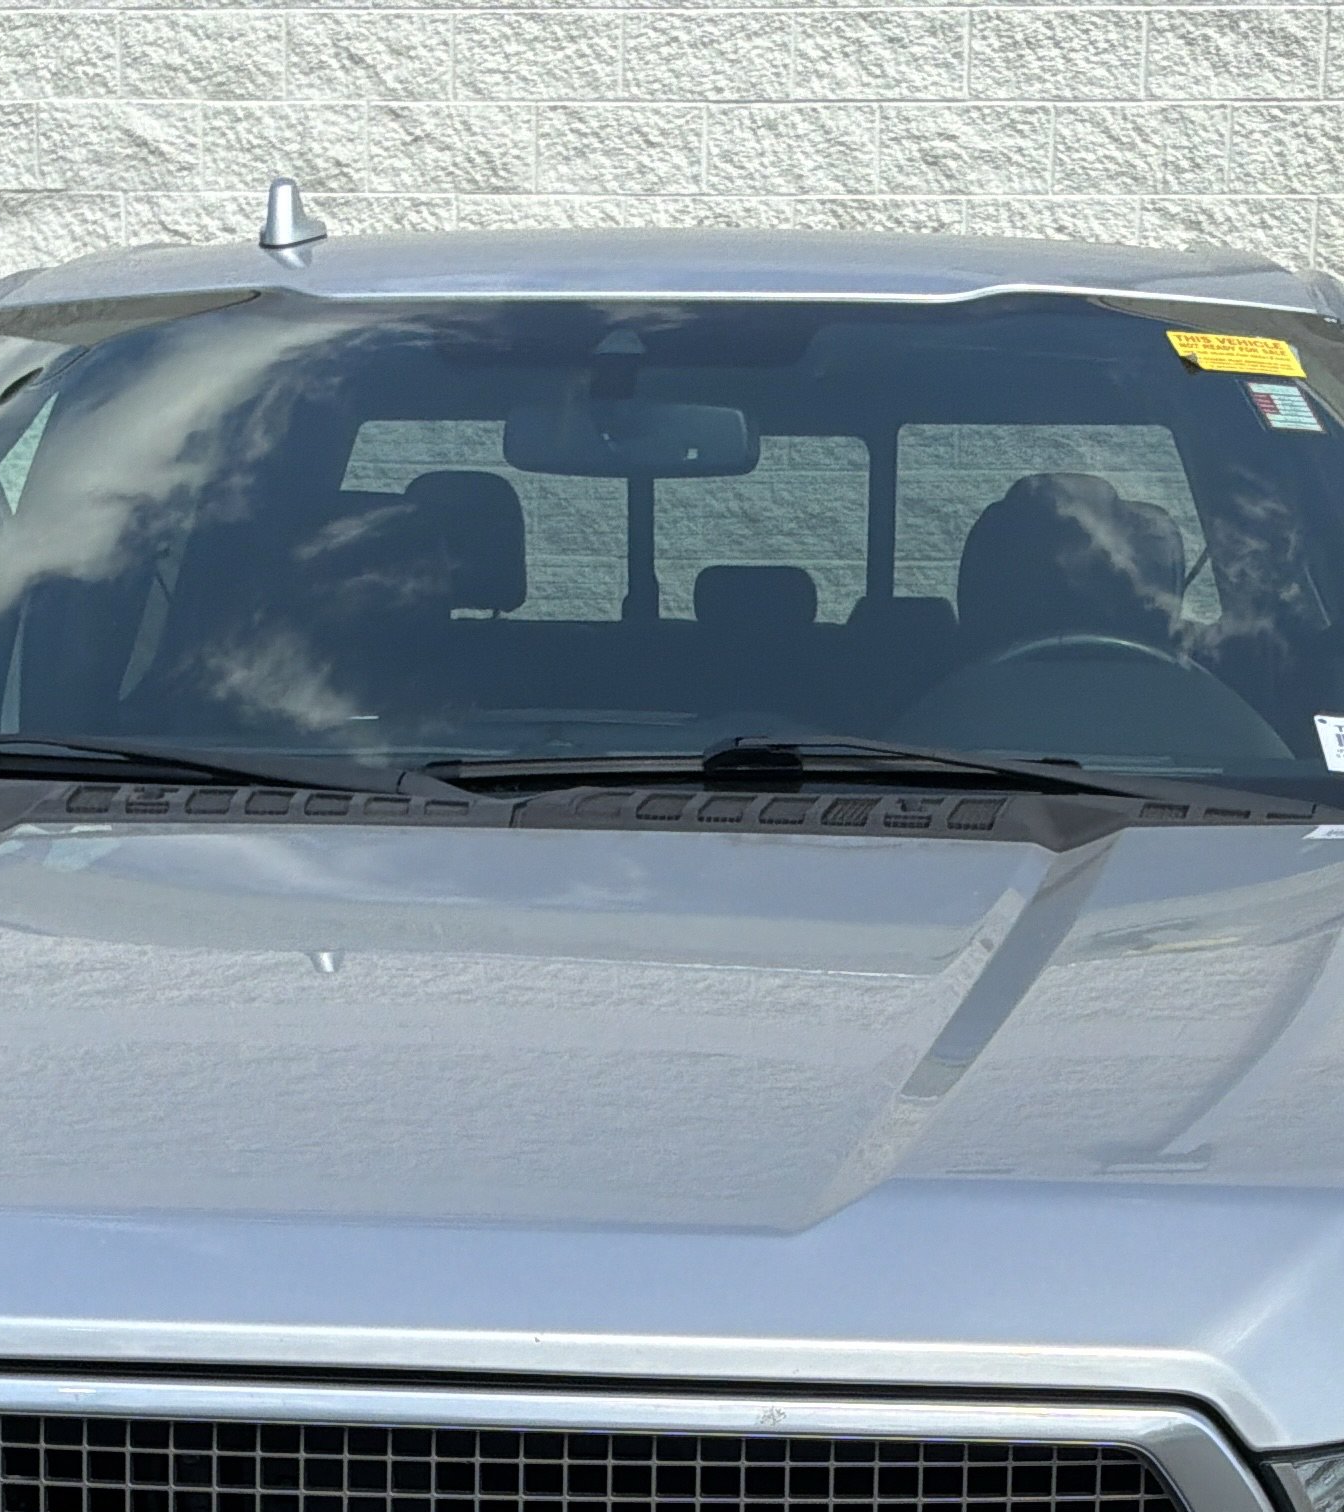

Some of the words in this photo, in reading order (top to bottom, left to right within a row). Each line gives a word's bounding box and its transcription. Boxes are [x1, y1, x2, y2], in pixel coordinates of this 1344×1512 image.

[1175, 335, 1212, 344] THIS
[1215, 337, 1283, 350] VEHICLE
[1203, 344, 1235, 352] READY
[1262, 348, 1288, 357] SALE
